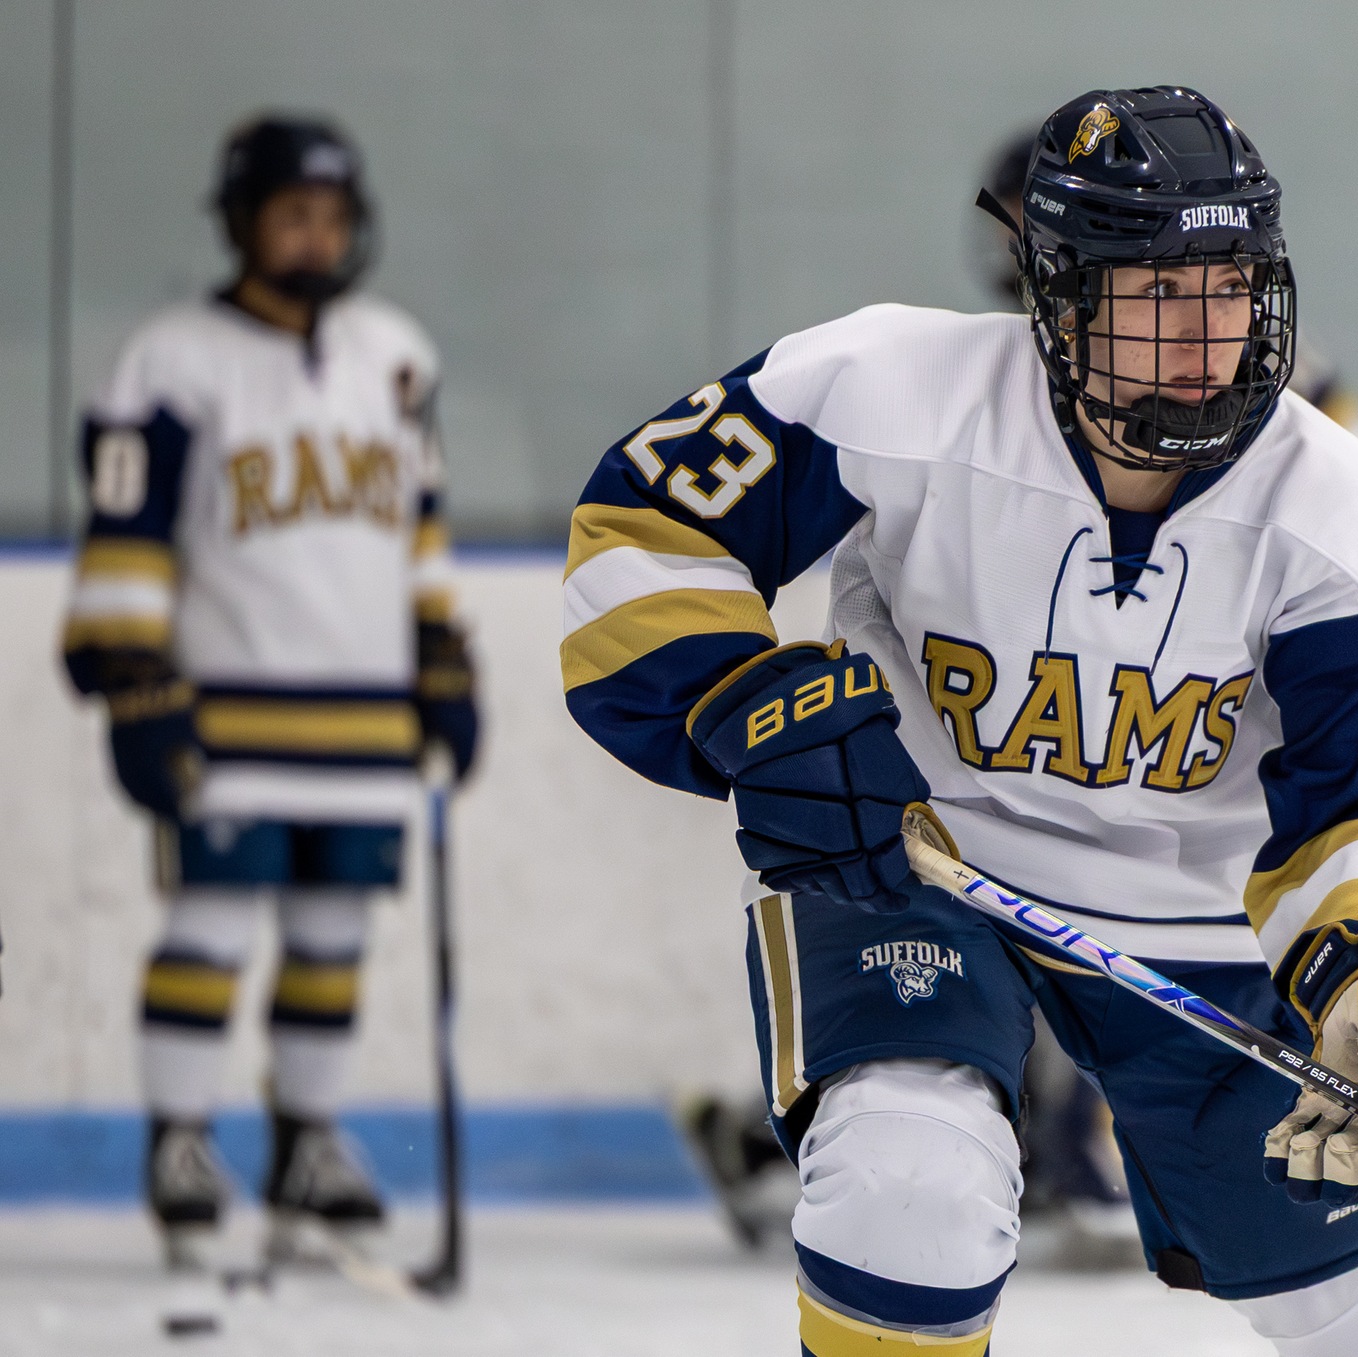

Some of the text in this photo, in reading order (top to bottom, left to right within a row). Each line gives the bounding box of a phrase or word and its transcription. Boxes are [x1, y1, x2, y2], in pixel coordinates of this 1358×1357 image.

[1179, 204, 1251, 232] SUFFOLK
[622, 381, 777, 519] 23
[1158, 433, 1229, 450] CCM
[920, 631, 1256, 794] RAMS
[861, 940, 964, 978] SUFFOLK
[1278, 1049, 1304, 1069] P92
[1309, 1067, 1329, 1082] 65
[1326, 1077, 1358, 1098] FLEX
